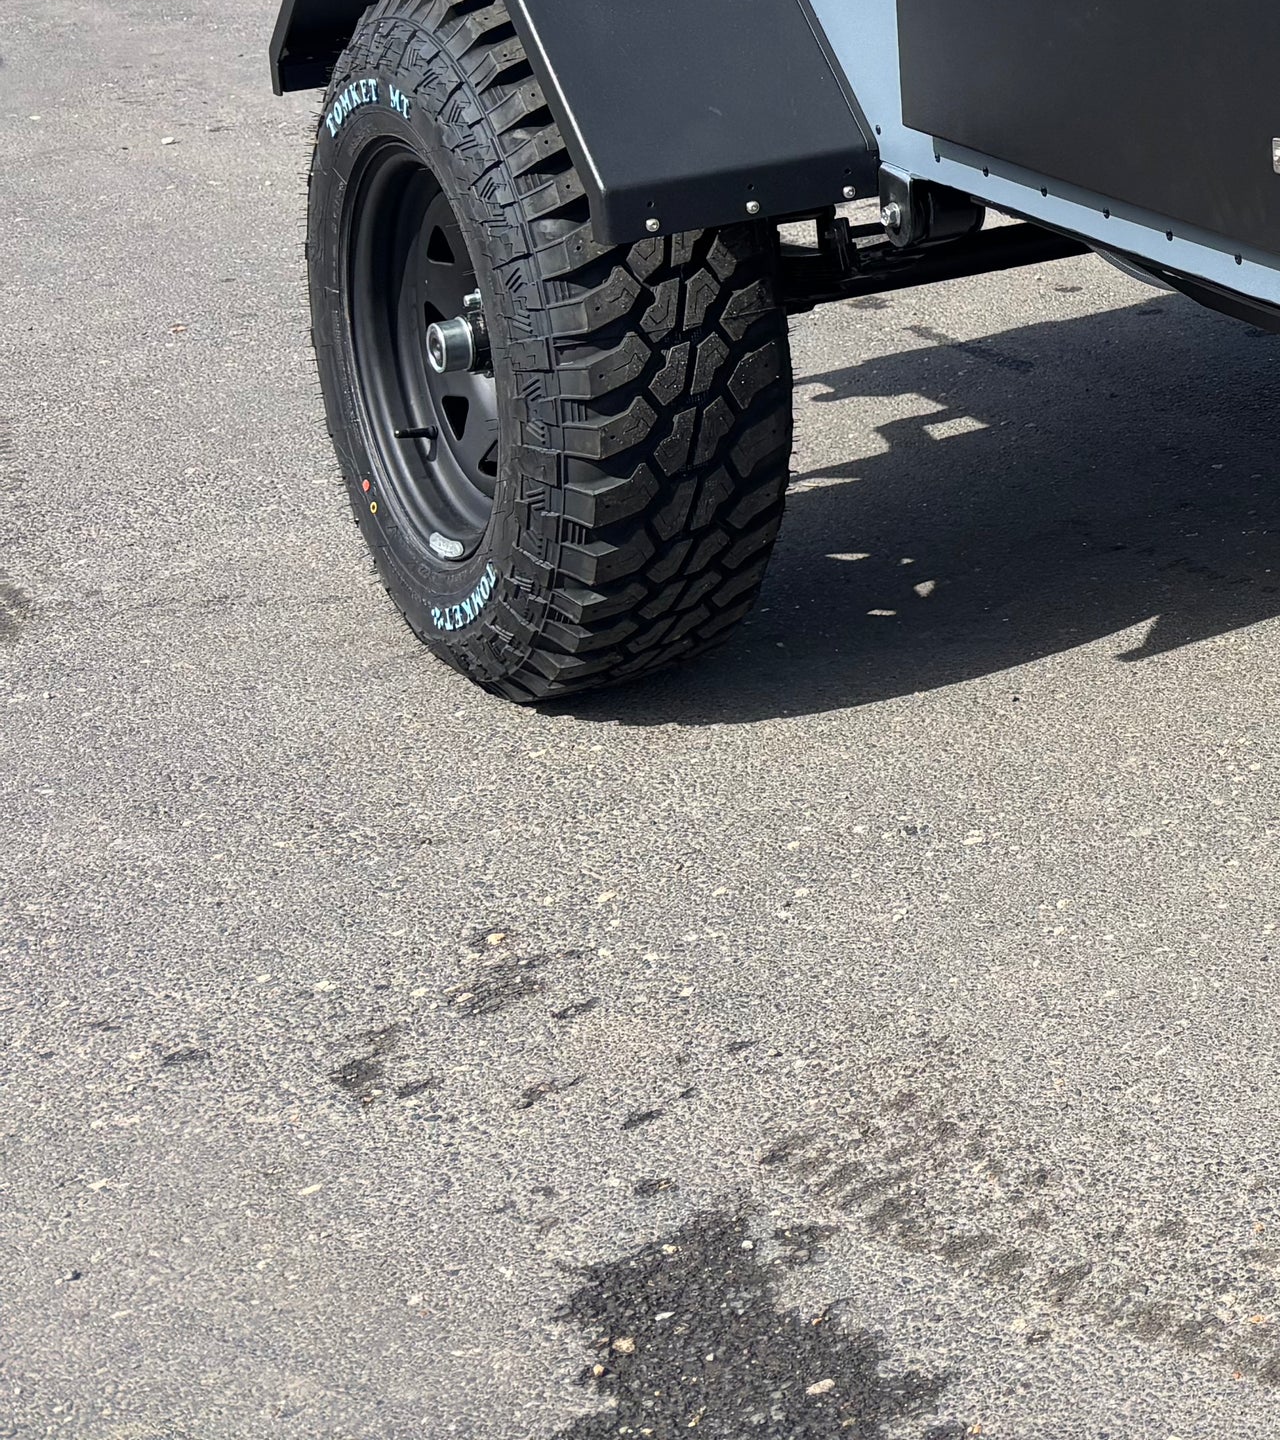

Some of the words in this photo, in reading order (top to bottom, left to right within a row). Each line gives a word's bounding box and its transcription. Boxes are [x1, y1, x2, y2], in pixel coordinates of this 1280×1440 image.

[325, 78, 379, 138] TOMKET
[389, 84, 410, 119] MT
[444, 562, 496, 631] TOMKET
